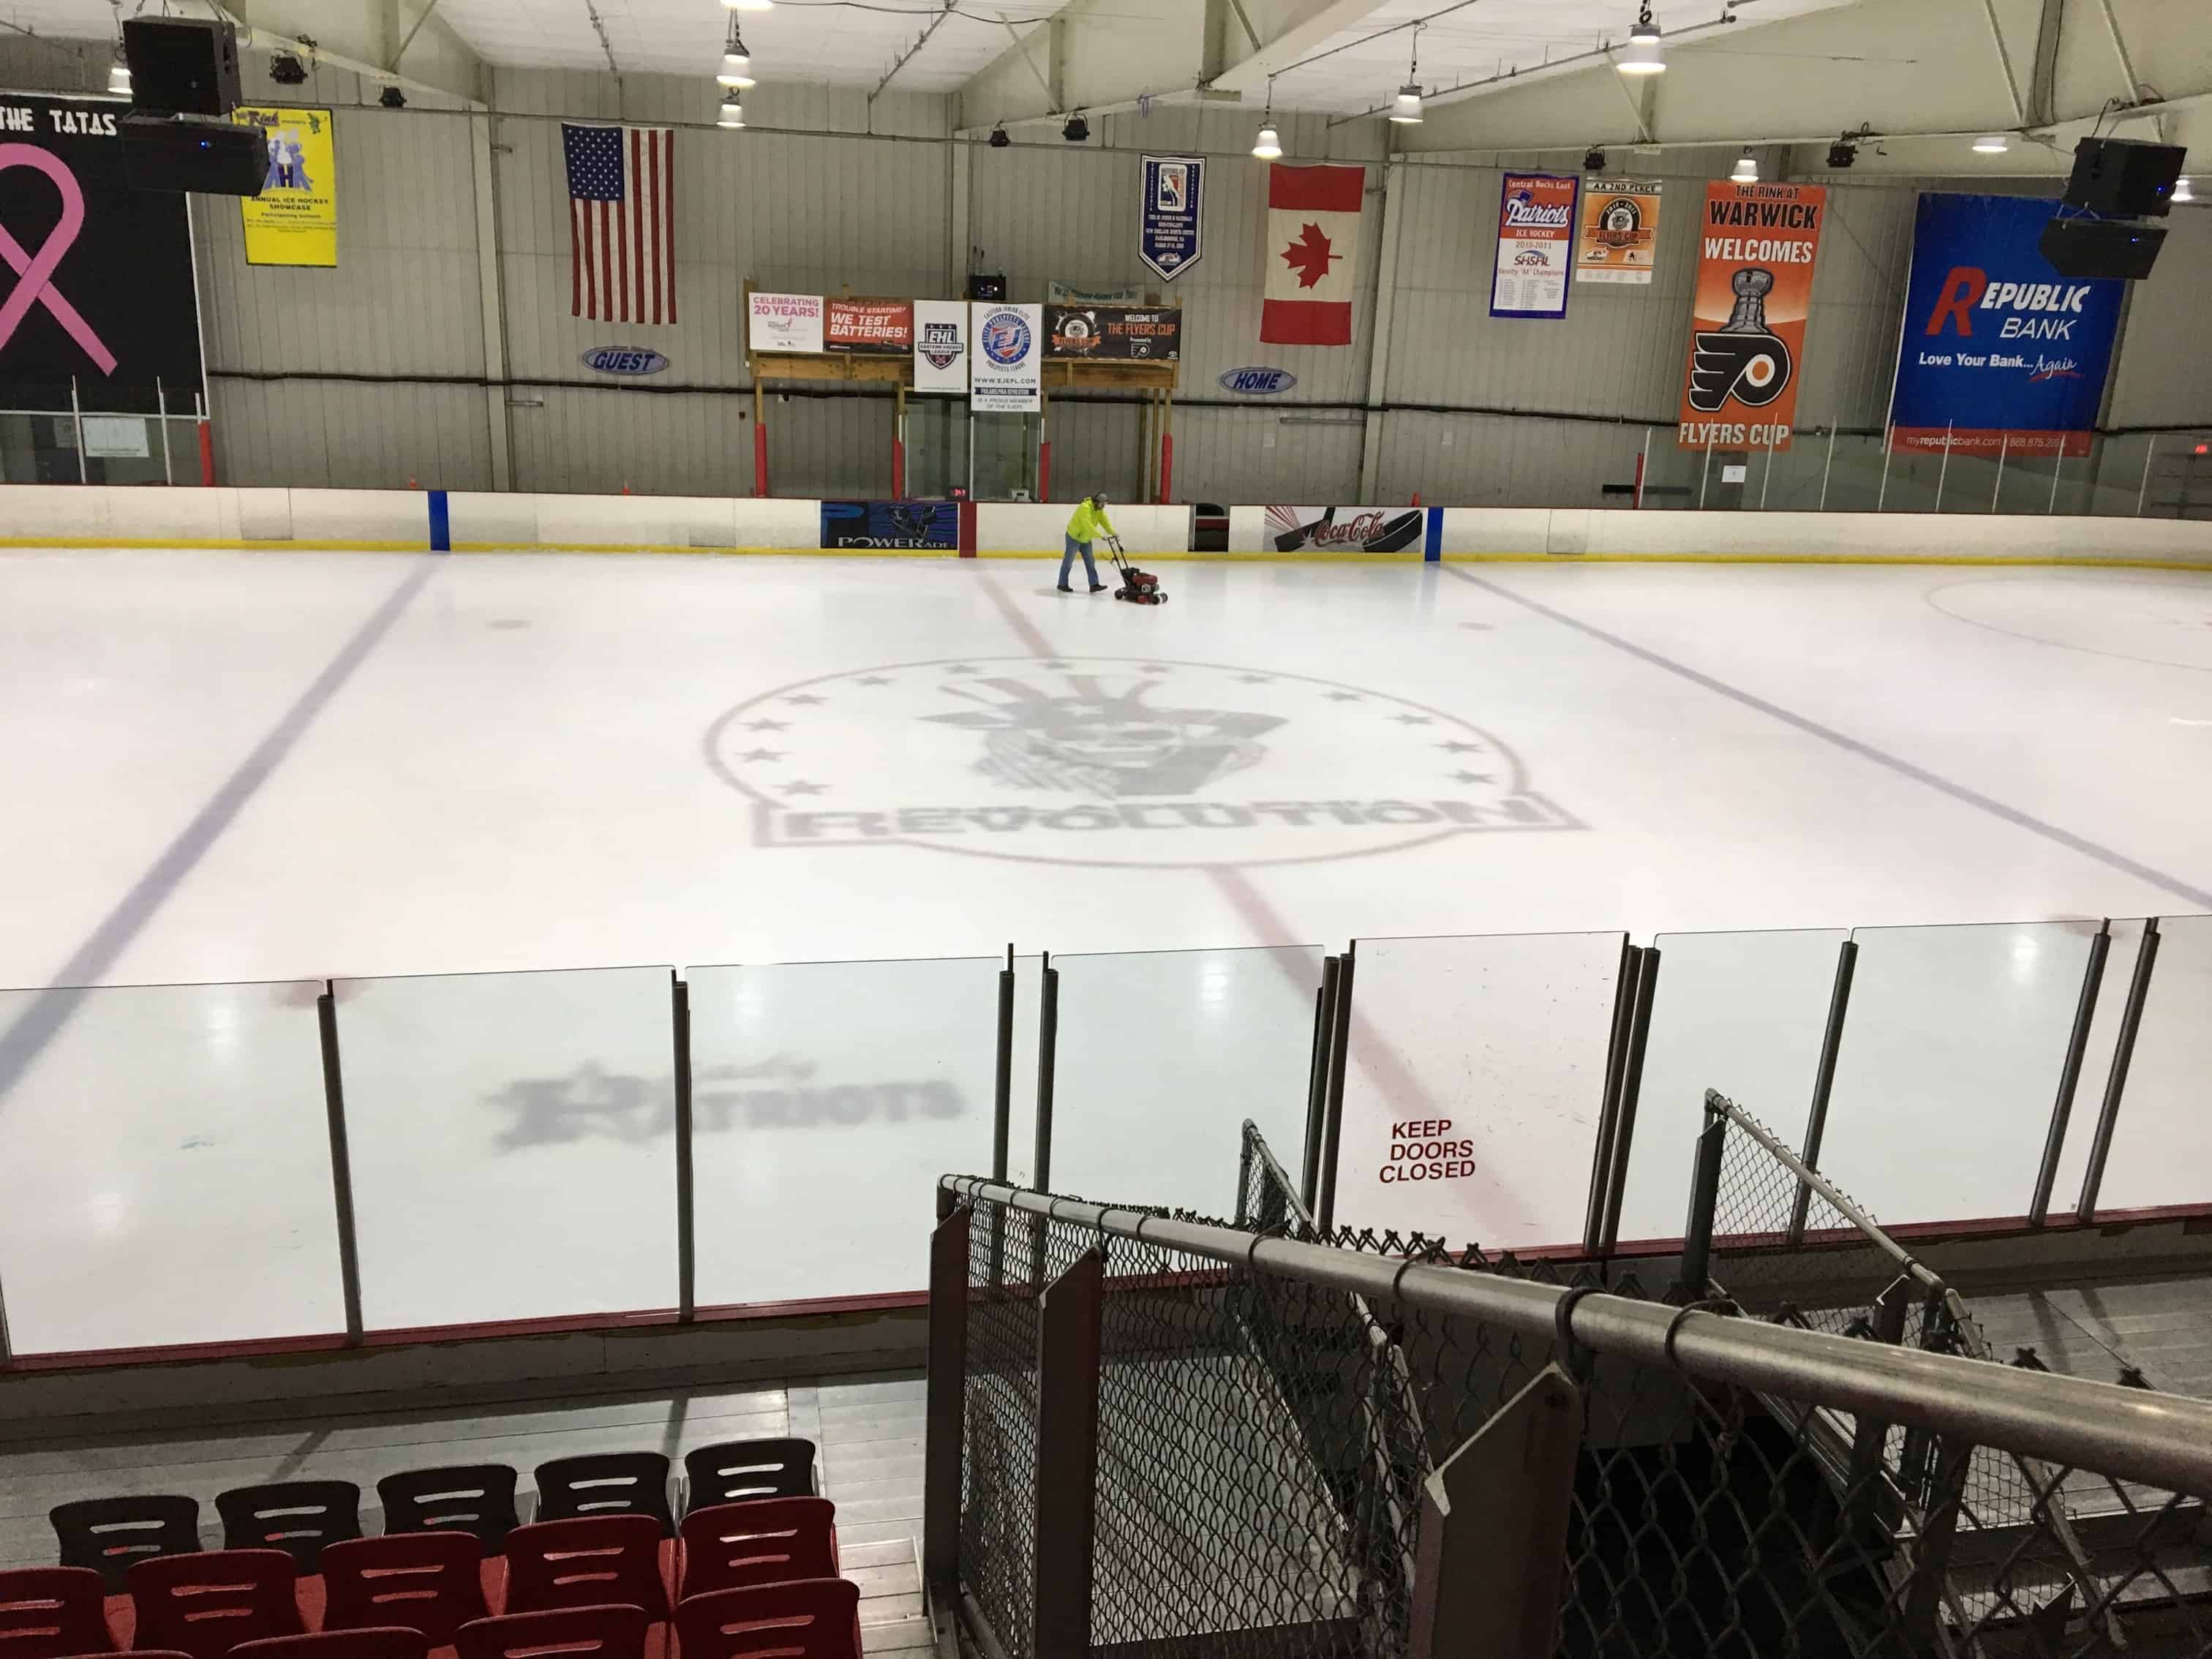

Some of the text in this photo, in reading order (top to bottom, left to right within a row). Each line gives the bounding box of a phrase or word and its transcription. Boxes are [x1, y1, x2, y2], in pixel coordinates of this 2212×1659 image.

[48, 109, 117, 136] TATAS
[1509, 179, 1571, 189] Central Bucks East
[1629, 184, 1656, 193] PLACE
[1736, 185, 1801, 200] THE RINK AT
[1505, 198, 1571, 227] Patriots
[1709, 200, 1818, 230] WARWICK
[1516, 229, 1555, 238] ICE HOCKEY
[1625, 231, 1639, 241] CUP
[1704, 238, 1813, 263] WELCOMES
[1513, 255, 1551, 266] SHSHL
[753, 296, 819, 306] CELEBRATING
[831, 303, 865, 314] TROUBLE
[1925, 266, 2091, 336] REPUBLIC
[754, 305, 819, 317] 20 YEARS!
[1125, 314, 1159, 323] WELCOME TO
[830, 312, 891, 326] WE TEST
[830, 324, 908, 339] BATTERIES!
[1107, 323, 1176, 335] THE FLYERS CUP
[2000, 317, 2077, 340] BANK
[929, 331, 953, 343] EHL
[594, 351, 656, 371] GUEST
[1919, 352, 1952, 365] Love
[1957, 353, 1986, 366] Your
[1233, 373, 1282, 390] HOME
[1679, 422, 1790, 445] FLYERS CUP
[1314, 511, 1386, 547] Coca-Cola
[838, 536, 949, 549] POWERADE
[780, 796, 1547, 843] REVOLUTION
[1392, 1119, 1452, 1139] KEEP
[1391, 1140, 1474, 1161] DOORS
[1380, 1160, 1475, 1184] CLOSED
